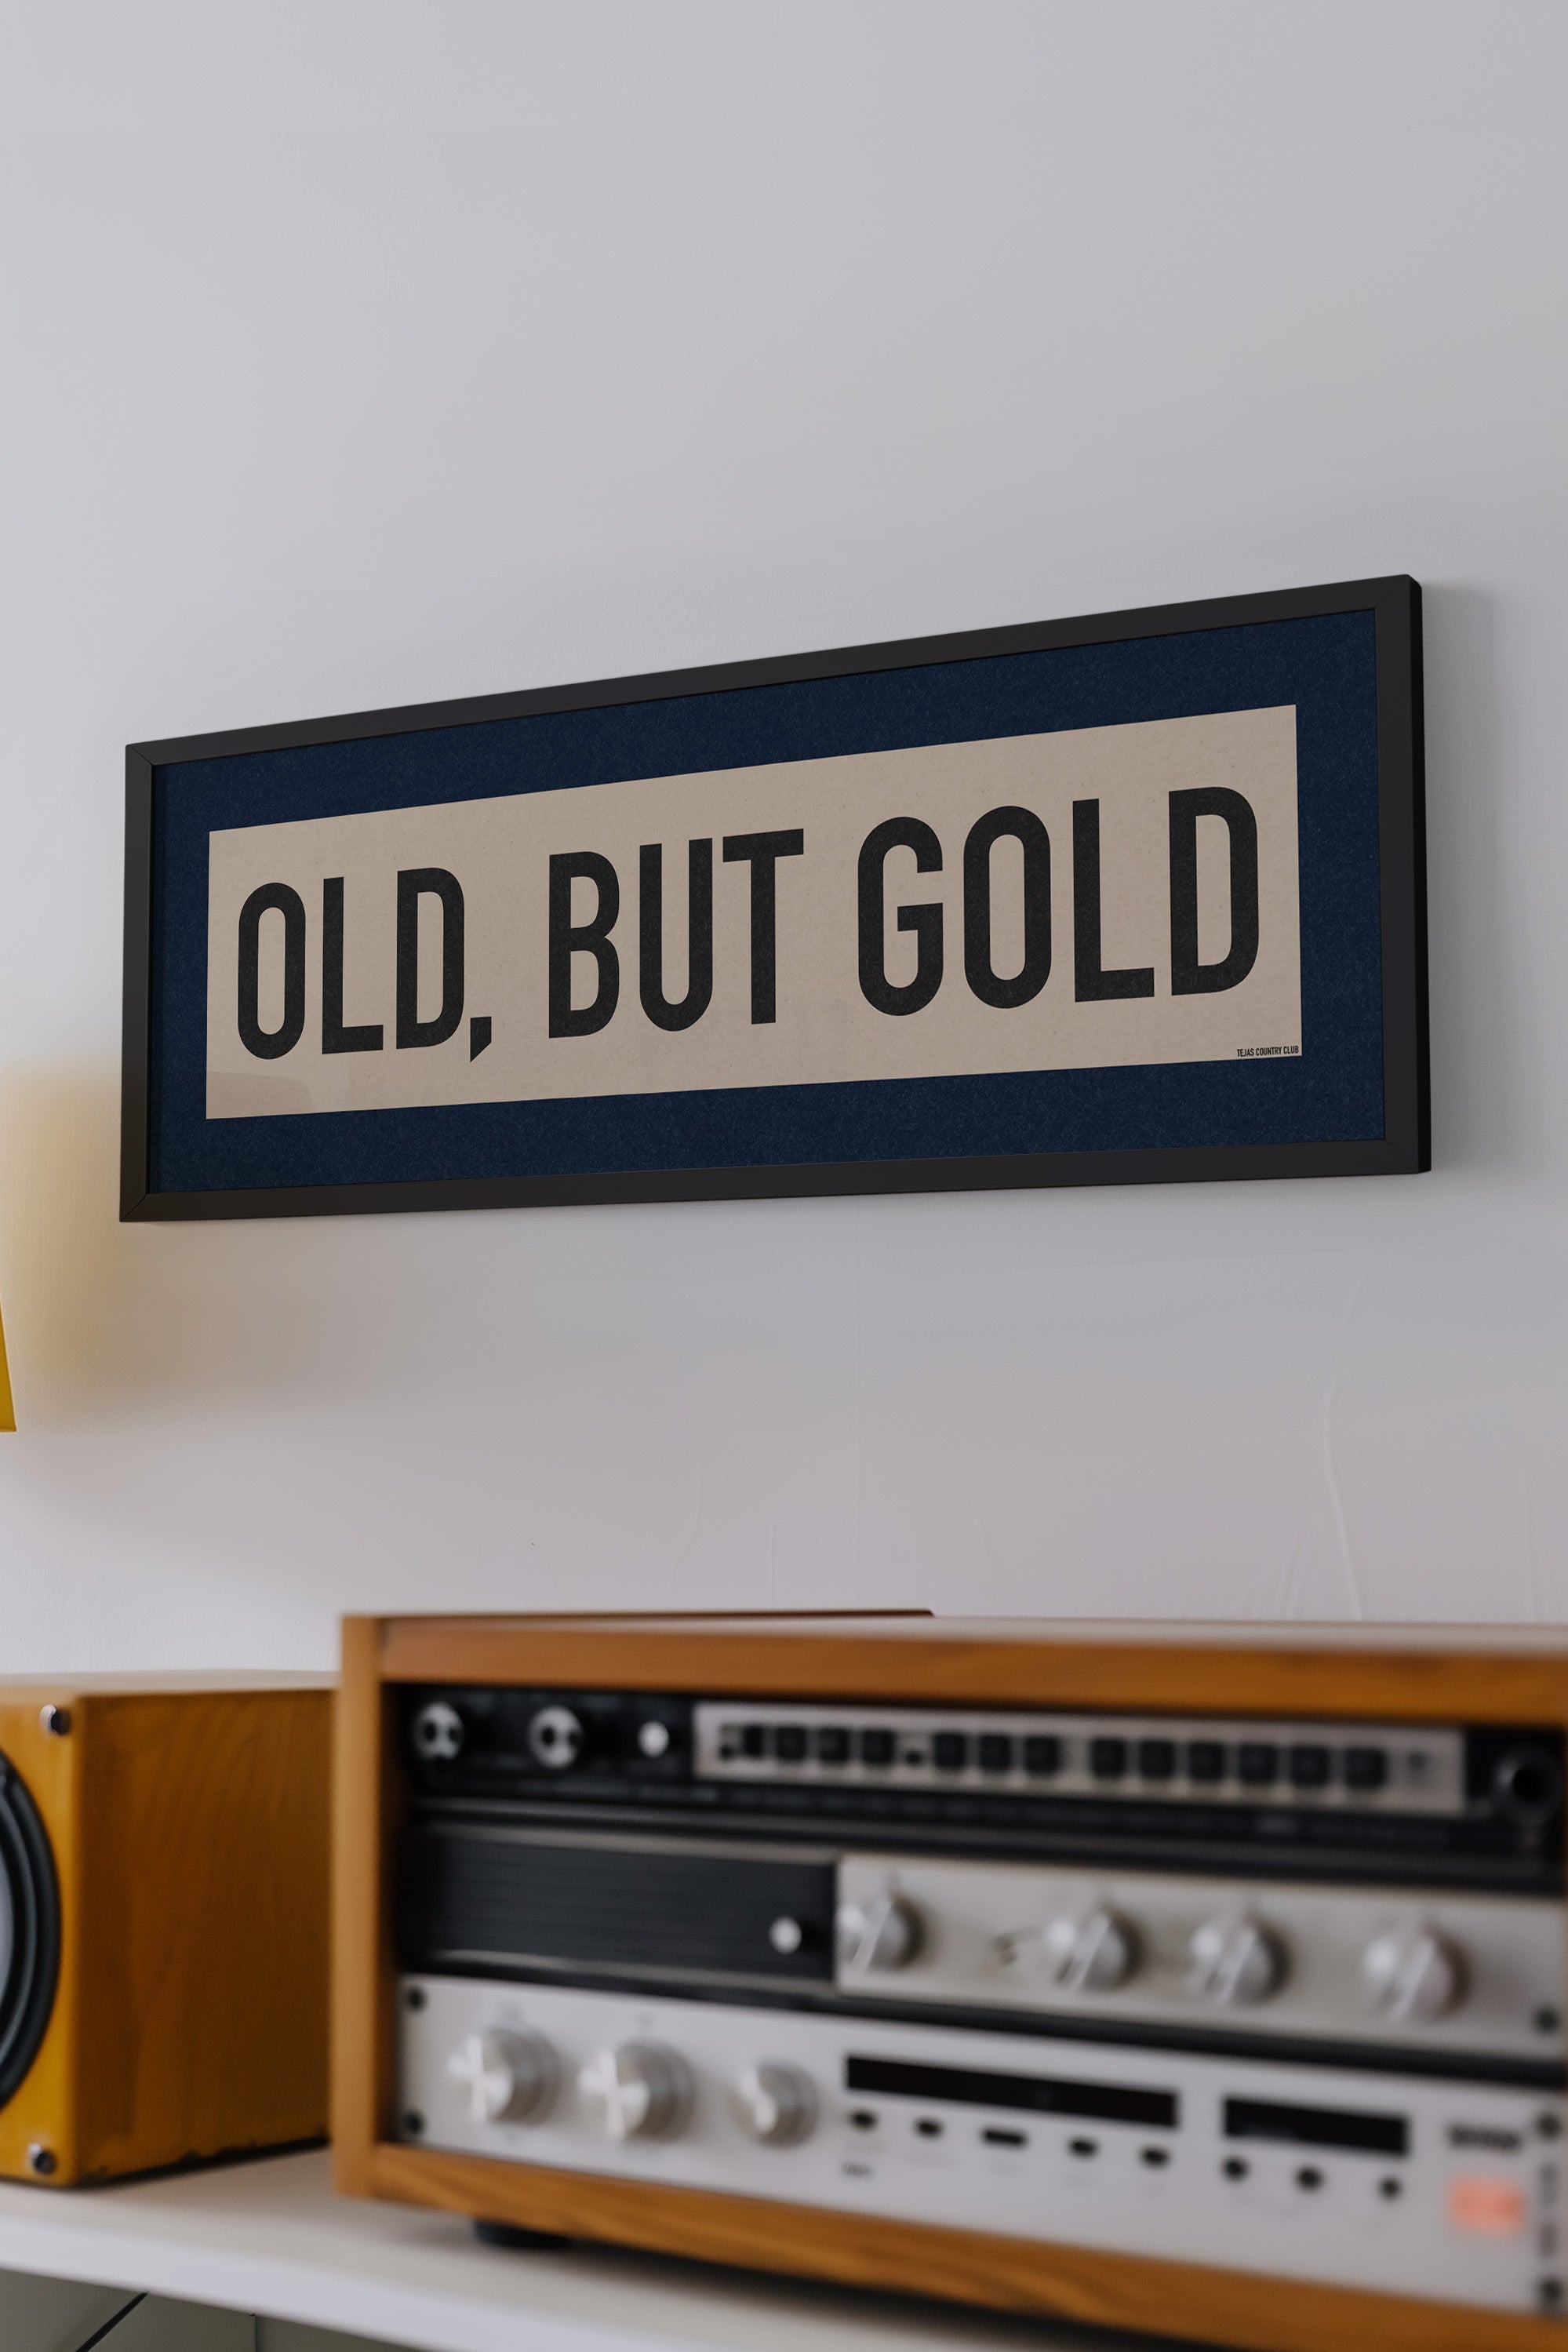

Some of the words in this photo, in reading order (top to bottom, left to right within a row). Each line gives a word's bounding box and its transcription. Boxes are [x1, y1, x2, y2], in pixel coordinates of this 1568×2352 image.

[237, 867, 493, 1063] OLD,
[548, 828, 805, 1039] BUT
[857, 786, 1260, 1017] GOLD
[1237, 1048, 1254, 1057] TEJAS
[1256, 1046, 1282, 1056] COUNTRY
[1283, 1045, 1299, 1054] CLUB
